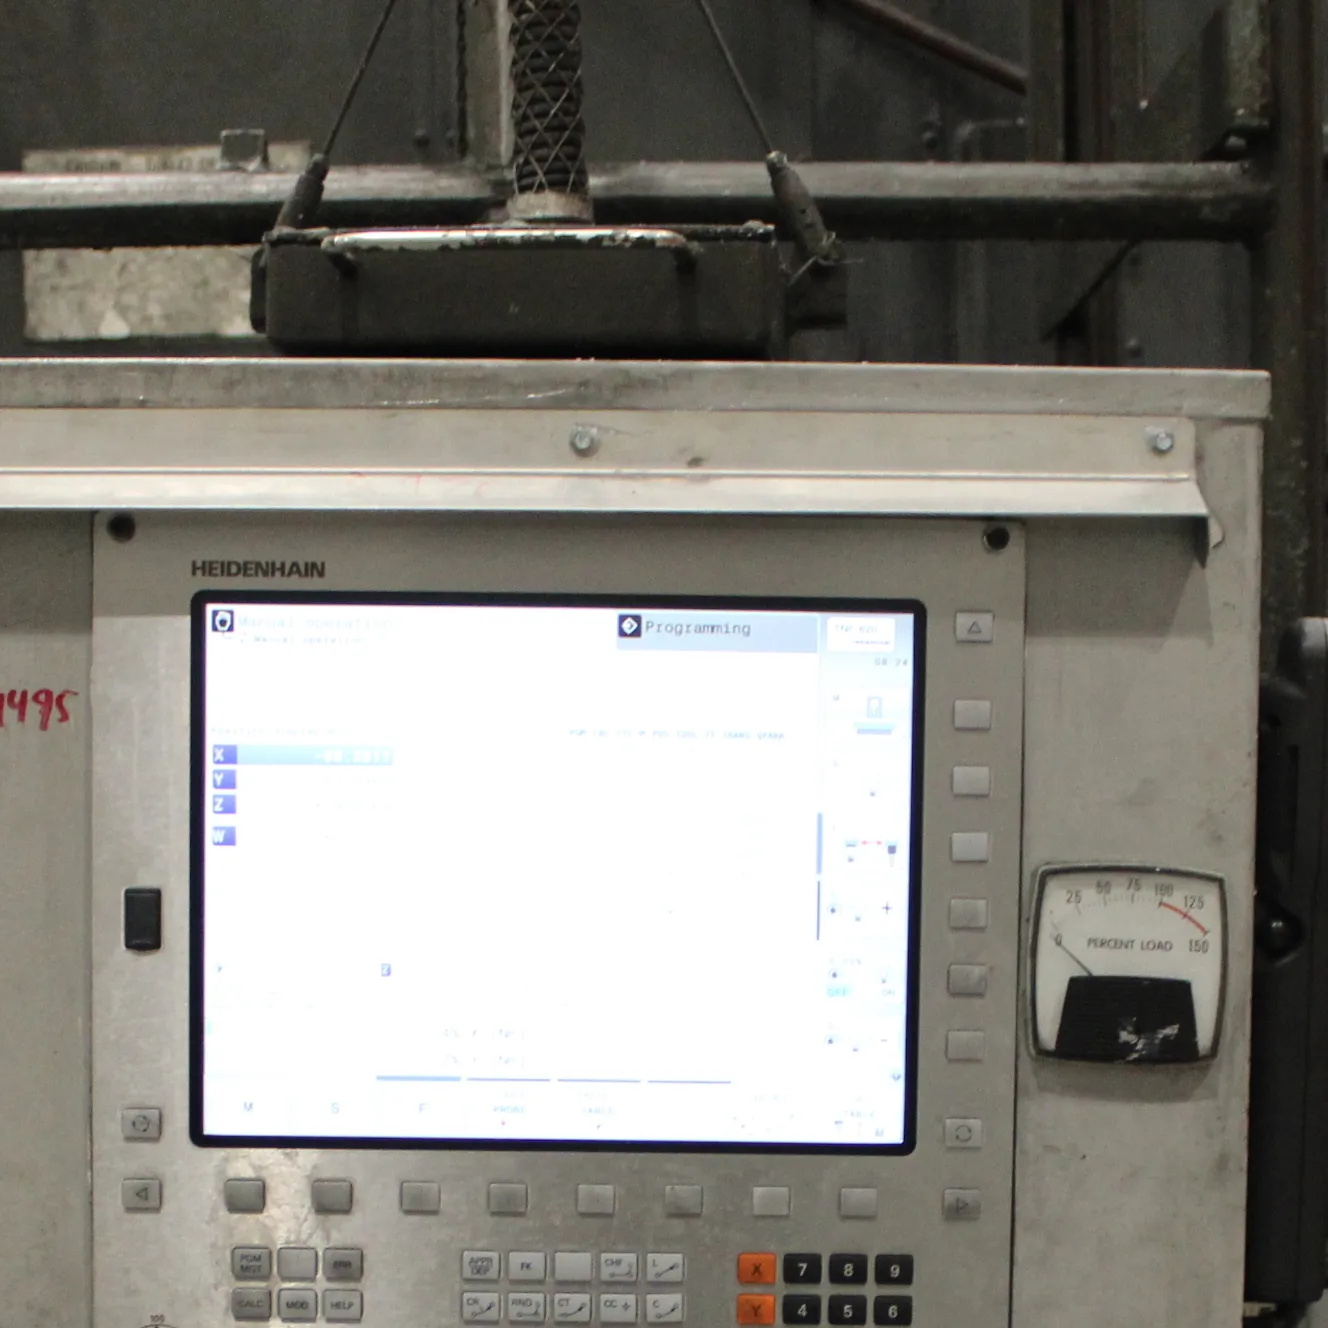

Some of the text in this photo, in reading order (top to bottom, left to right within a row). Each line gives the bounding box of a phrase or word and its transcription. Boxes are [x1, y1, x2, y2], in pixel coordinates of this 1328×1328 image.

[191, 560, 326, 578] HEIDENHAIN
[645, 620, 751, 637] Programming
[1126, 878, 1142, 892] 75
[1154, 883, 1174, 897] 100
[1065, 890, 1082, 904] 25
[1183, 895, 1205, 910] 125
[1087, 937, 1174, 951] PERCENT LOAD
[1188, 939, 1209, 954] 150
[751, 1263, 762, 1276] X
[798, 1263, 808, 1276] 7
[844, 1263, 854, 1277] 8
[890, 1264, 900, 1278] 9
[330, 1301, 354, 1310] HELP
[751, 1305, 761, 1318] Y
[797, 1304, 808, 1317] 4
[843, 1305, 853, 1318] 5
[888, 1305, 898, 1318] 6
